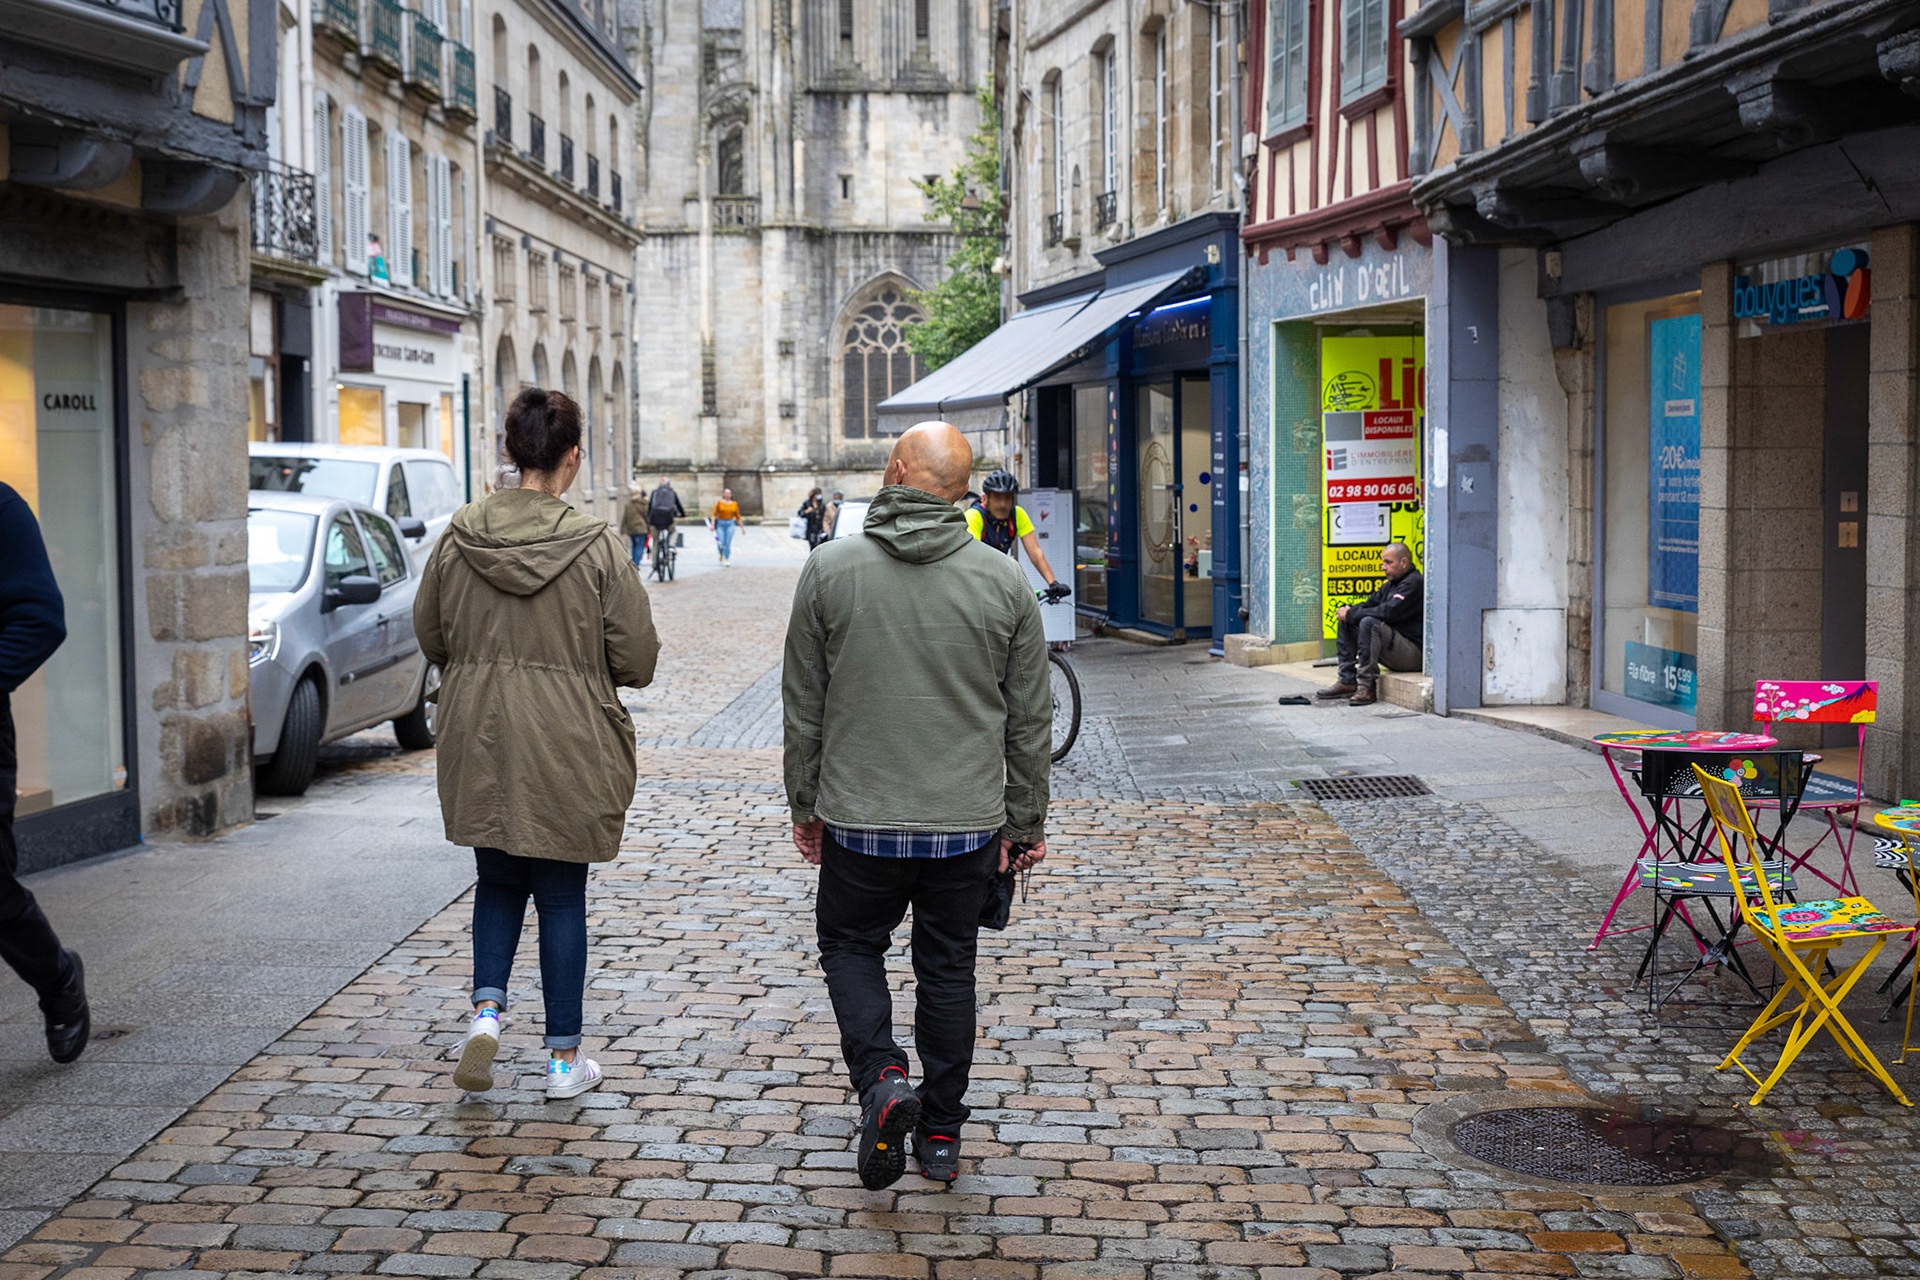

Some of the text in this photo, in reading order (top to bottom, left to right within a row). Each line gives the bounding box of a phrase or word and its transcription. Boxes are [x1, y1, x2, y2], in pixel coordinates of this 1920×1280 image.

[1734, 276, 1821, 324] bouygues
[44, 394, 97, 411] CAROLL
[1373, 415, 1404, 425] LOCAUX
[1365, 424, 1413, 435] DISPONIBLES
[1328, 482, 1413, 498] 02 98 90 06 06
[1336, 550, 1383, 561] LOCAUX
[1328, 563, 1384, 573] DISPONIBLE
[1337, 579, 1388, 594] 53 00 8
[1639, 665, 1656, 684] fibre
